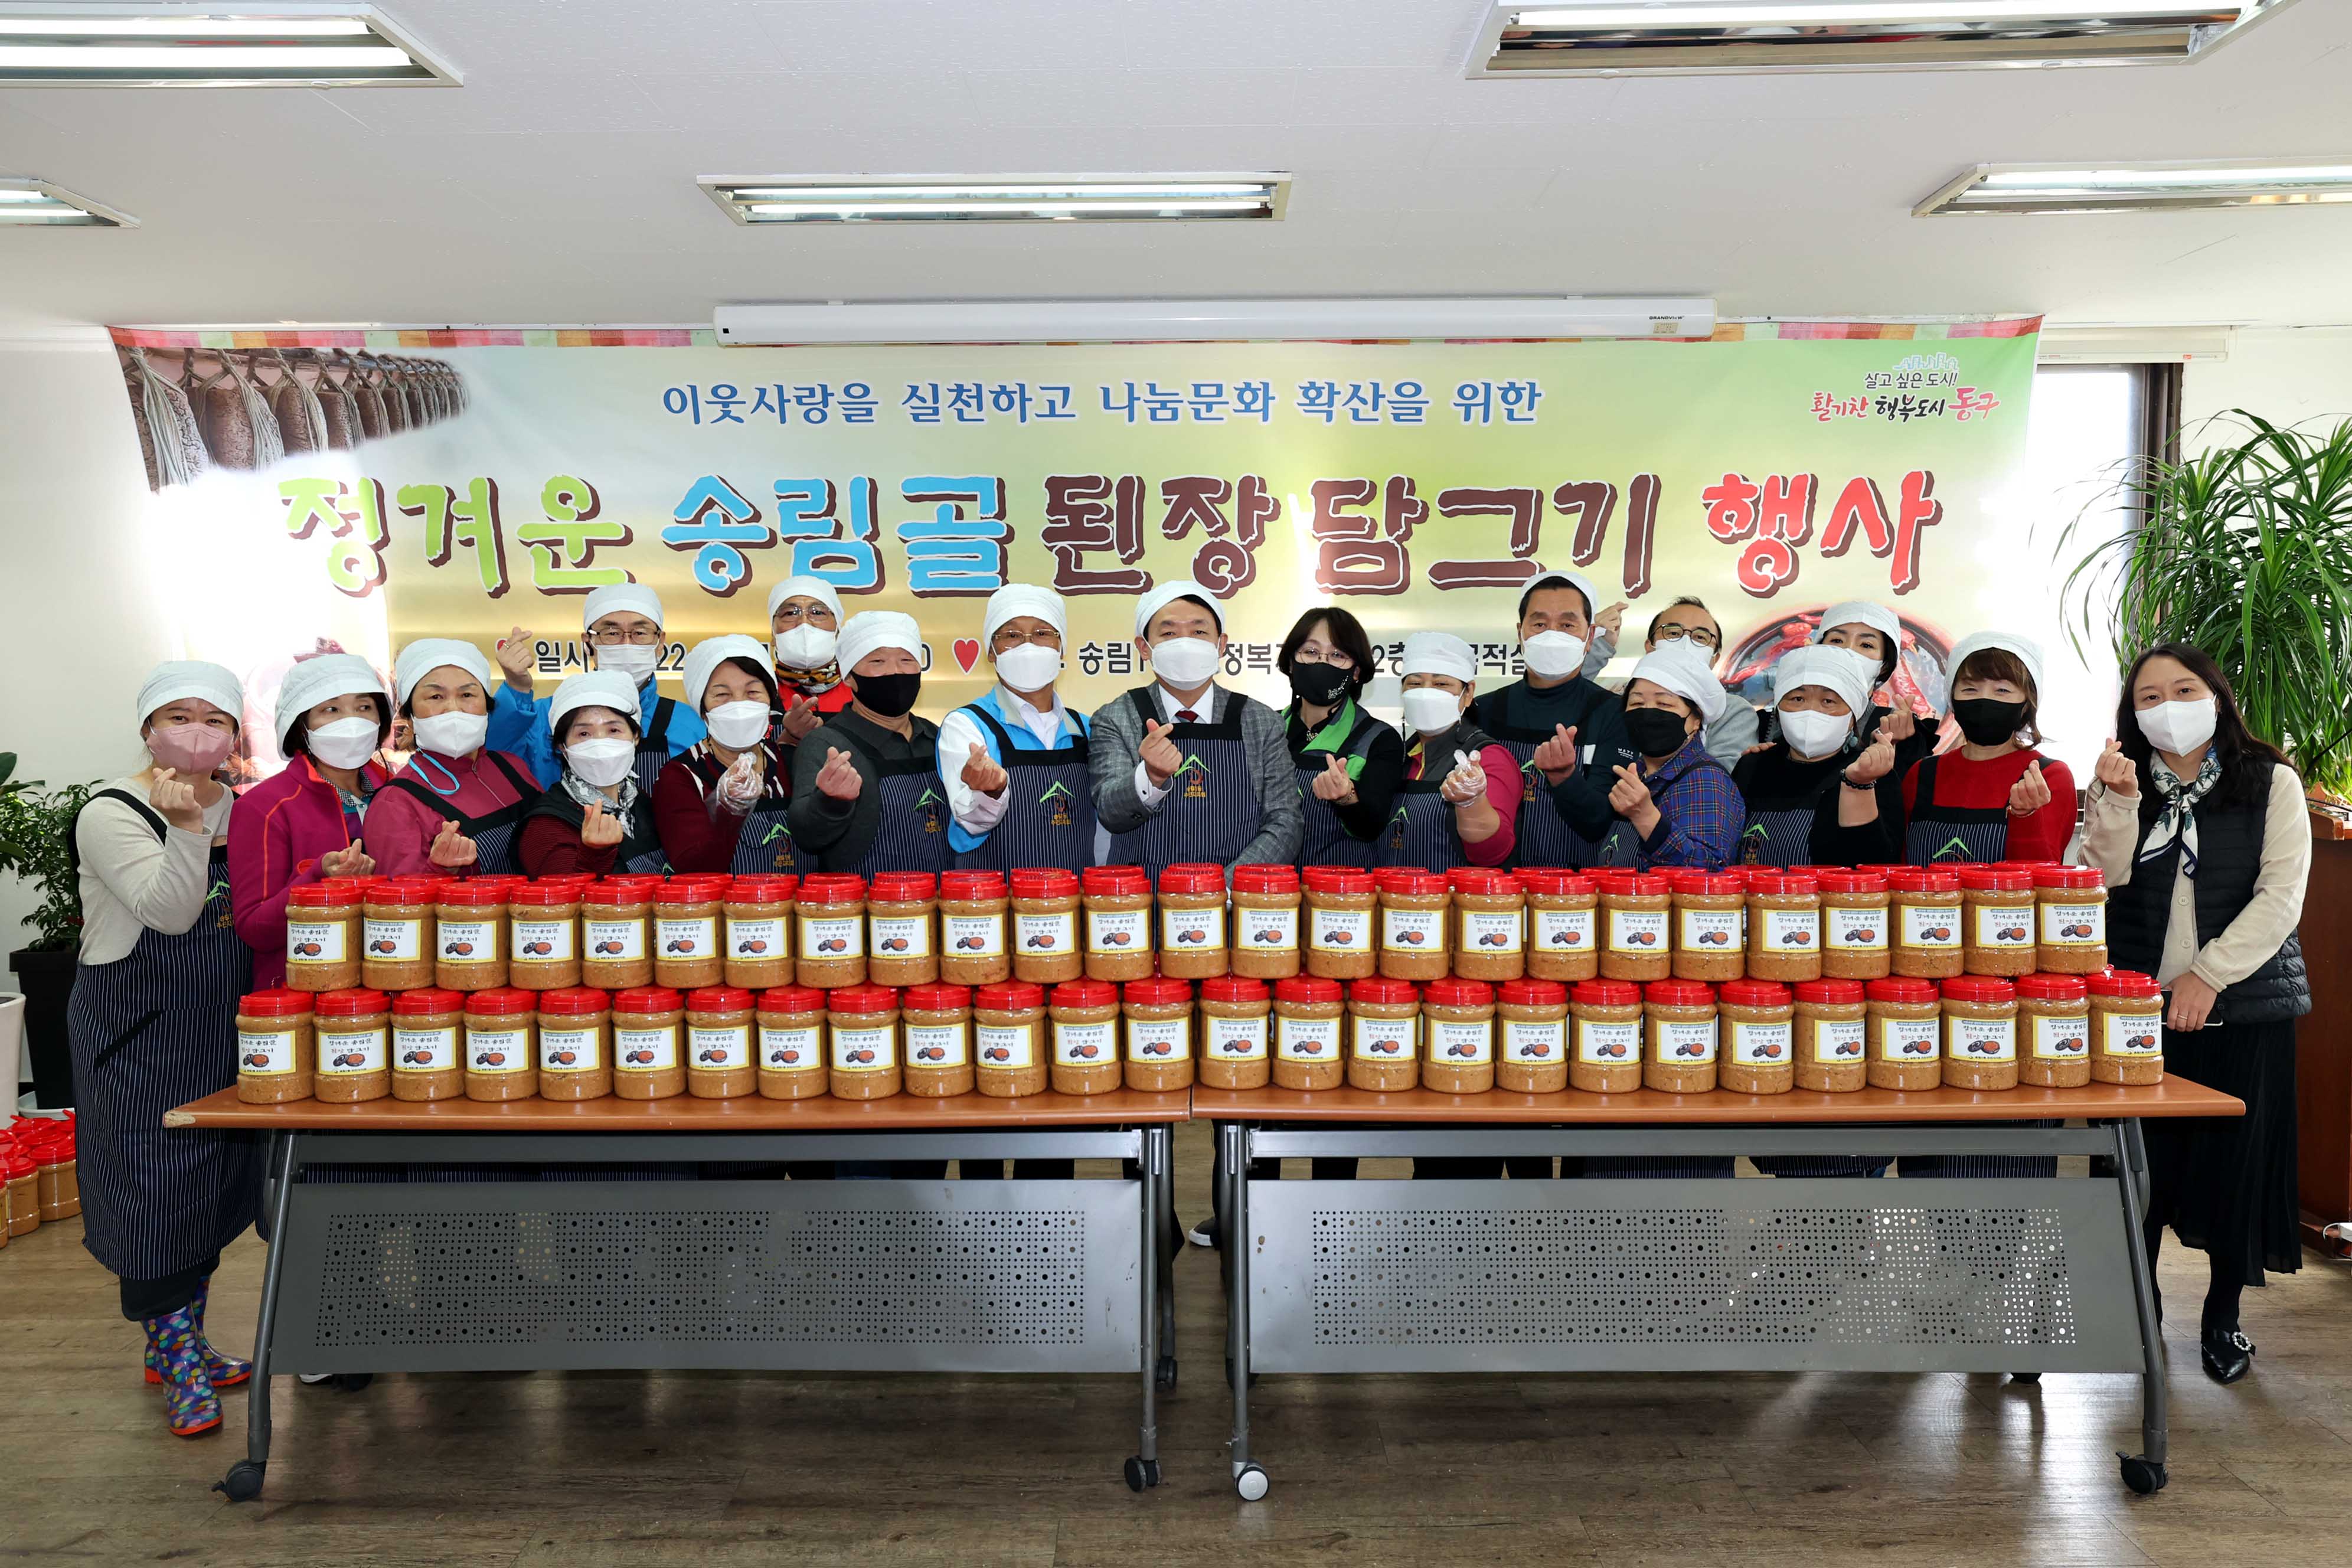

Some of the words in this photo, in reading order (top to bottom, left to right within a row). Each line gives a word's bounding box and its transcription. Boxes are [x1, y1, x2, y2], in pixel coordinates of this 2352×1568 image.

[1864, 372, 1893, 388] 살고
[1896, 373, 1923, 388] 싶은
[1928, 372, 1958, 388] 도시!
[663, 382, 879, 425] 이웃사랑을
[901, 383, 1076, 424] 실천하고
[1101, 381, 1276, 423] 나눔문화
[1298, 381, 1430, 423] 확산을
[1453, 381, 1543, 424] 위한
[1810, 392, 1869, 422] 활기찬
[1875, 394, 1946, 423] 행복도시
[1948, 387, 2000, 422] 동구
[279, 474, 636, 598] 정겨운
[661, 473, 1015, 597] 송림골
[1040, 472, 1282, 599] 된장
[1308, 472, 1662, 599] 담그기
[1701, 469, 1944, 599] 행사
[535, 641, 588, 672] 일시
